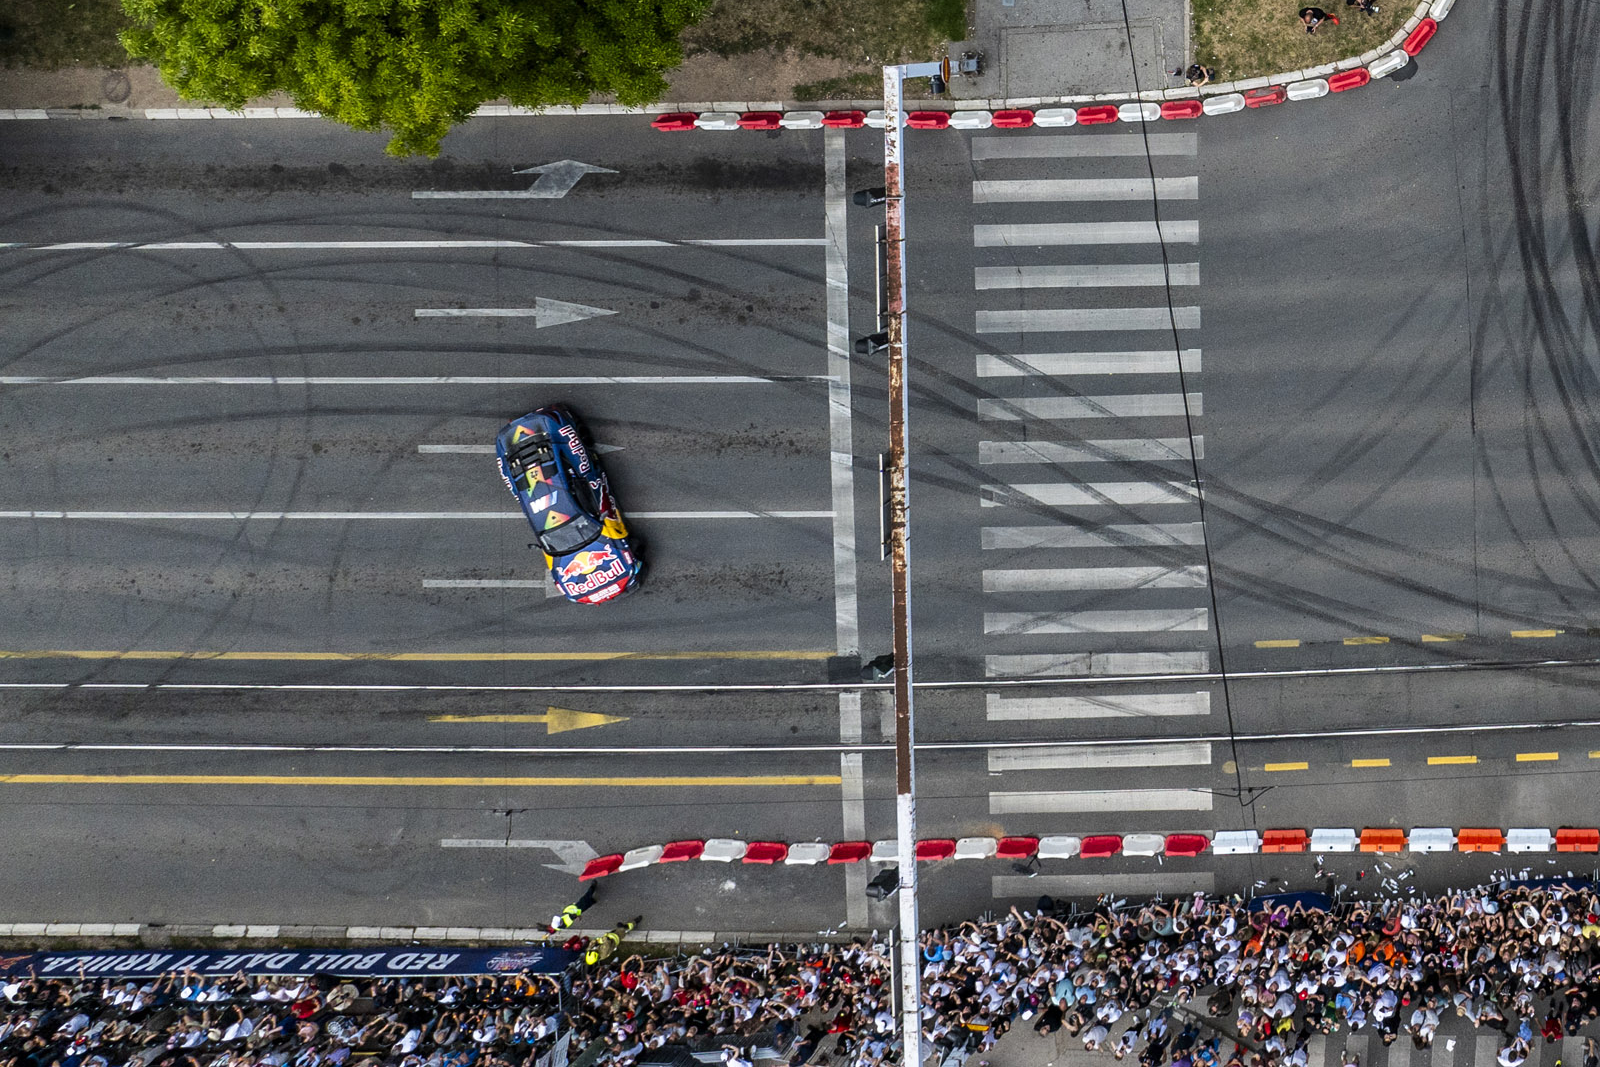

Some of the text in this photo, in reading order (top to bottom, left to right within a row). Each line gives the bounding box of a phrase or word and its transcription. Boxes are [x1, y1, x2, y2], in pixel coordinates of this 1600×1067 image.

[166, 954, 210, 971] TI
[205, 952, 300, 971] DAJE
[299, 952, 386, 971] BULL
[386, 953, 461, 971] RED
